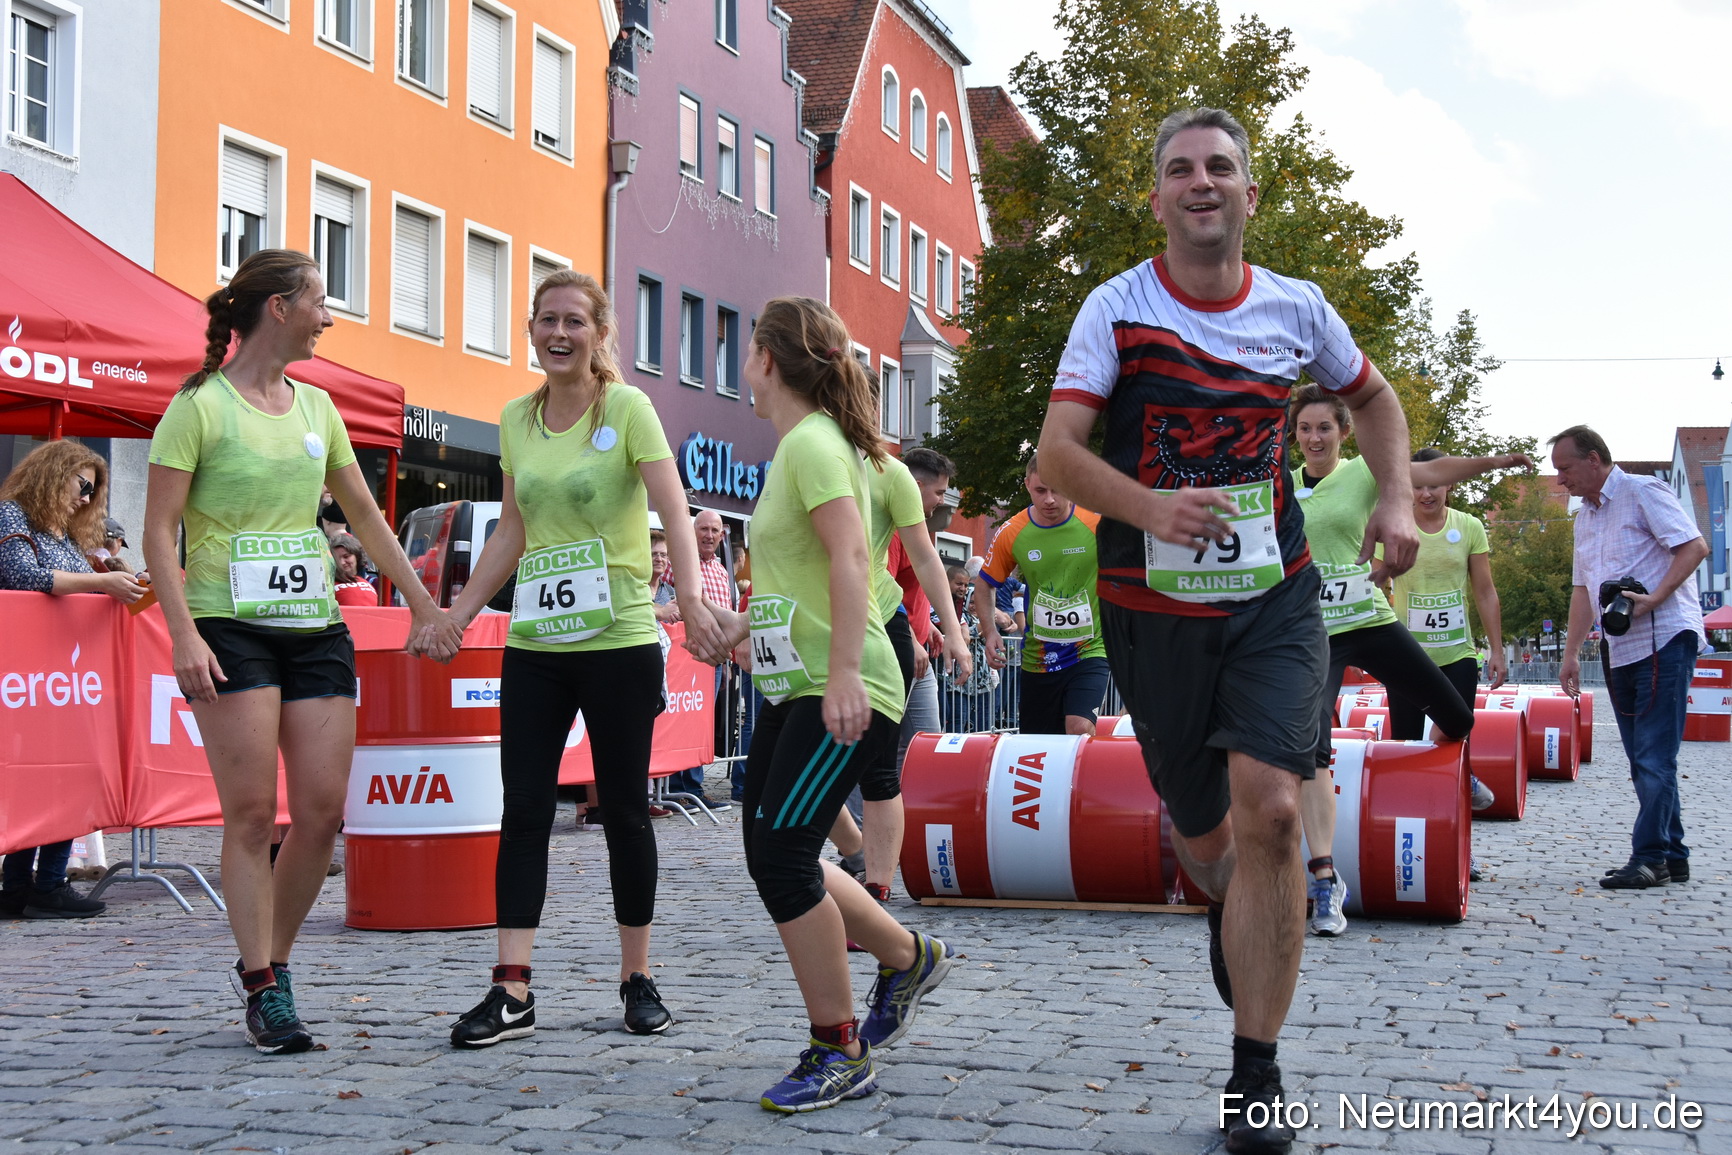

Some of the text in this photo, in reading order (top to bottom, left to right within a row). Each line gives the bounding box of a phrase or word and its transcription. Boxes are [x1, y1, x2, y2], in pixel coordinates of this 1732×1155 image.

[237, 534, 321, 558] BOCK
[521, 544, 597, 581] BOCK
[268, 564, 308, 593] 49
[1177, 573, 1256, 590] RAINER
[538, 579, 576, 611] 46
[1320, 581, 1348, 602] 47
[1411, 592, 1460, 609] BOCK
[255, 603, 319, 617] CARMEN
[1322, 606, 1356, 619] JULIA
[535, 616, 587, 635] SILVIA
[1425, 612, 1449, 629] 45
[1426, 633, 1449, 642] SUSI
[753, 636, 777, 668] 44
[760, 677, 791, 693] NADJA
